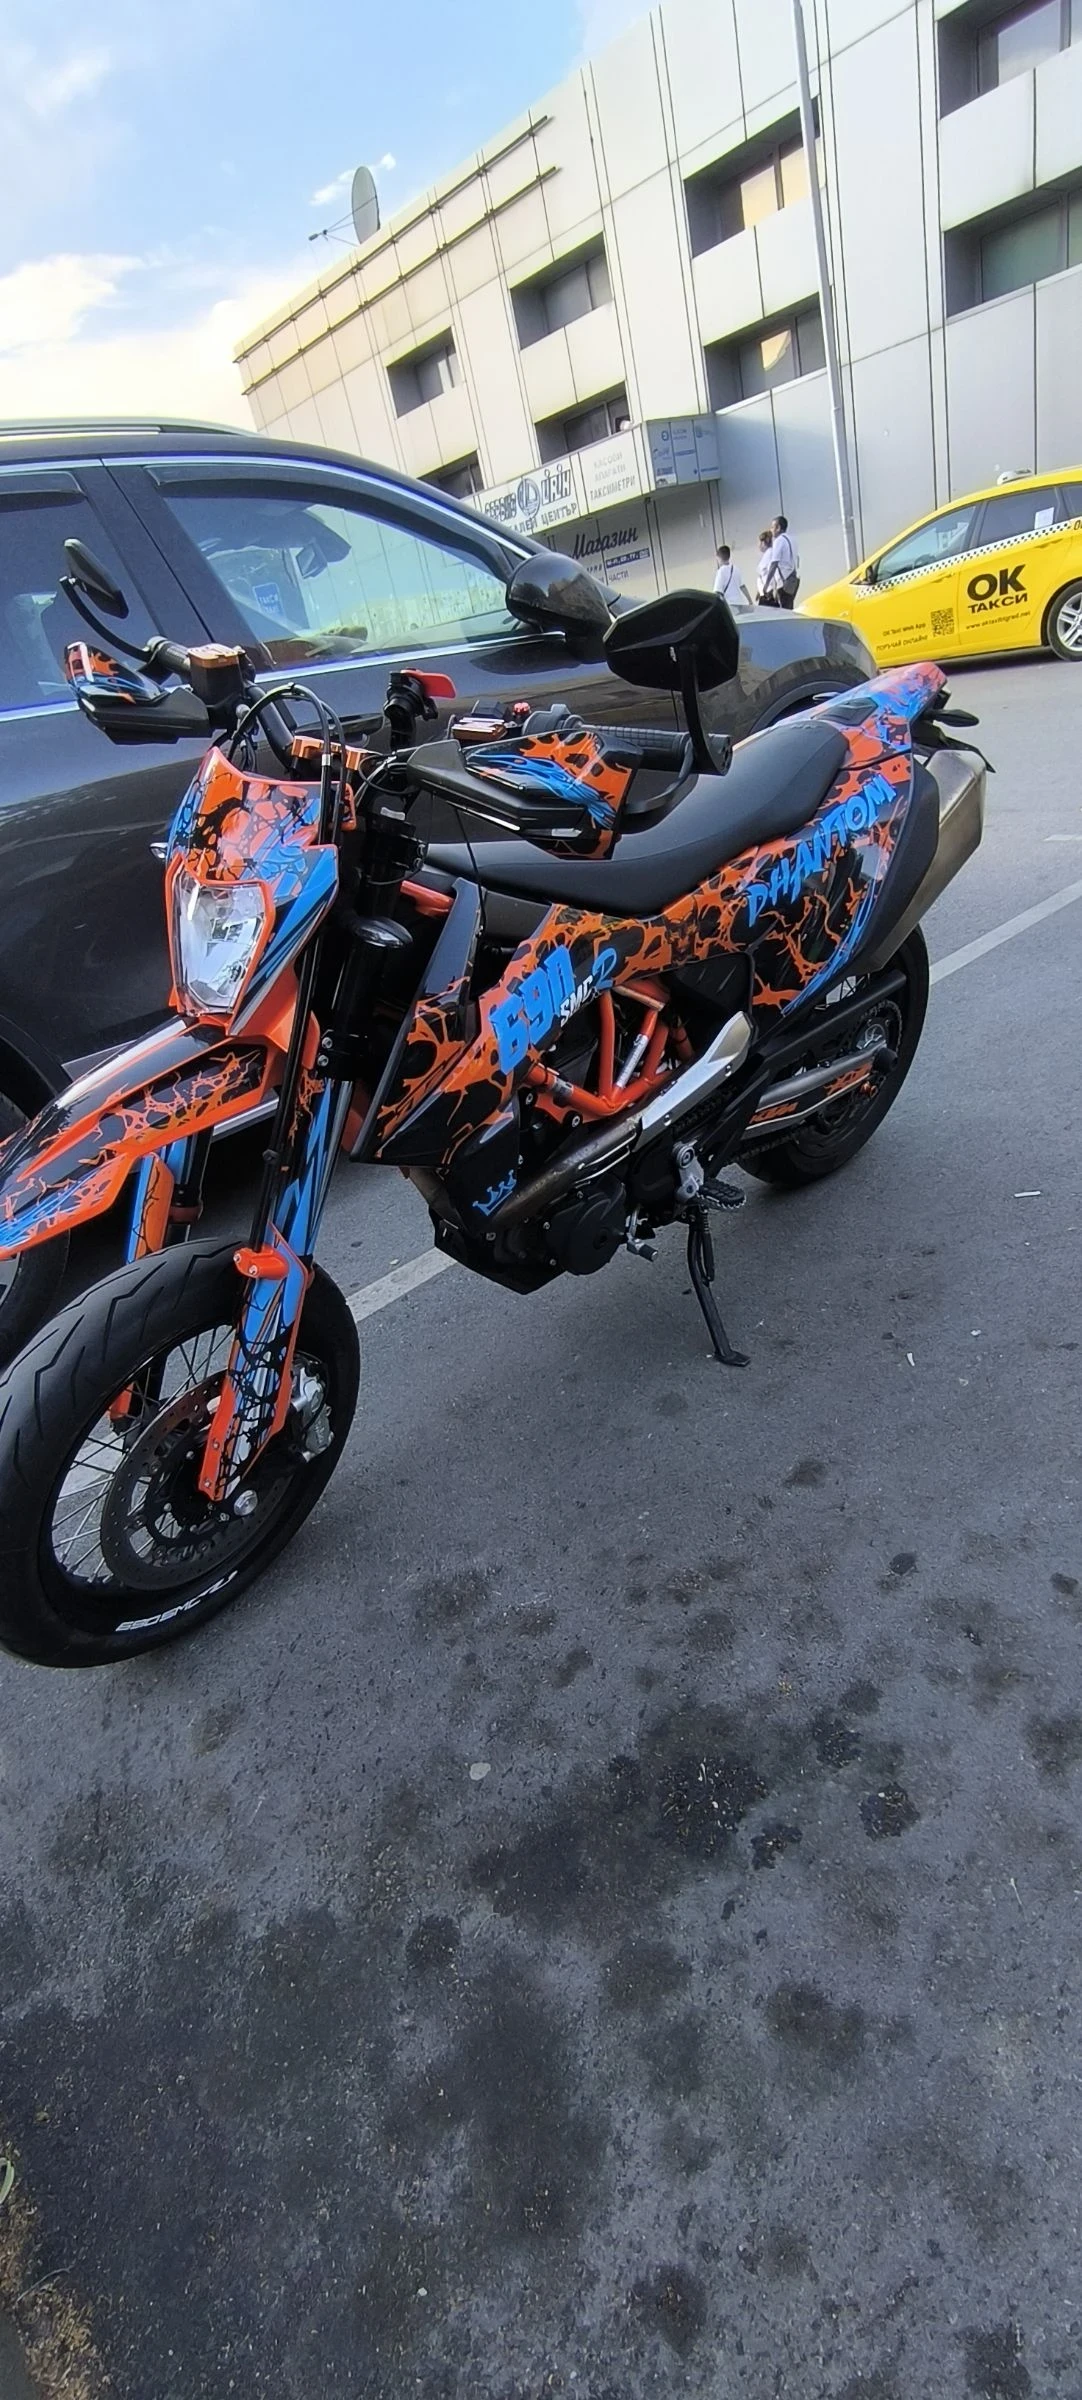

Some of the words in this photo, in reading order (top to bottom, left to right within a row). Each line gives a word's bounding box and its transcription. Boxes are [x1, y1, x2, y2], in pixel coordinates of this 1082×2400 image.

[589, 475, 636, 500] ТАКСИМЕТРИ
[541, 503, 577, 527] ЦЕНТЪР
[572, 527, 638, 560] Магазин
[967, 564, 1026, 602] OK
[968, 592, 1029, 614] ТАКСИ
[743, 772, 898, 928] PHANTOM
[489, 944, 577, 1076] 690
